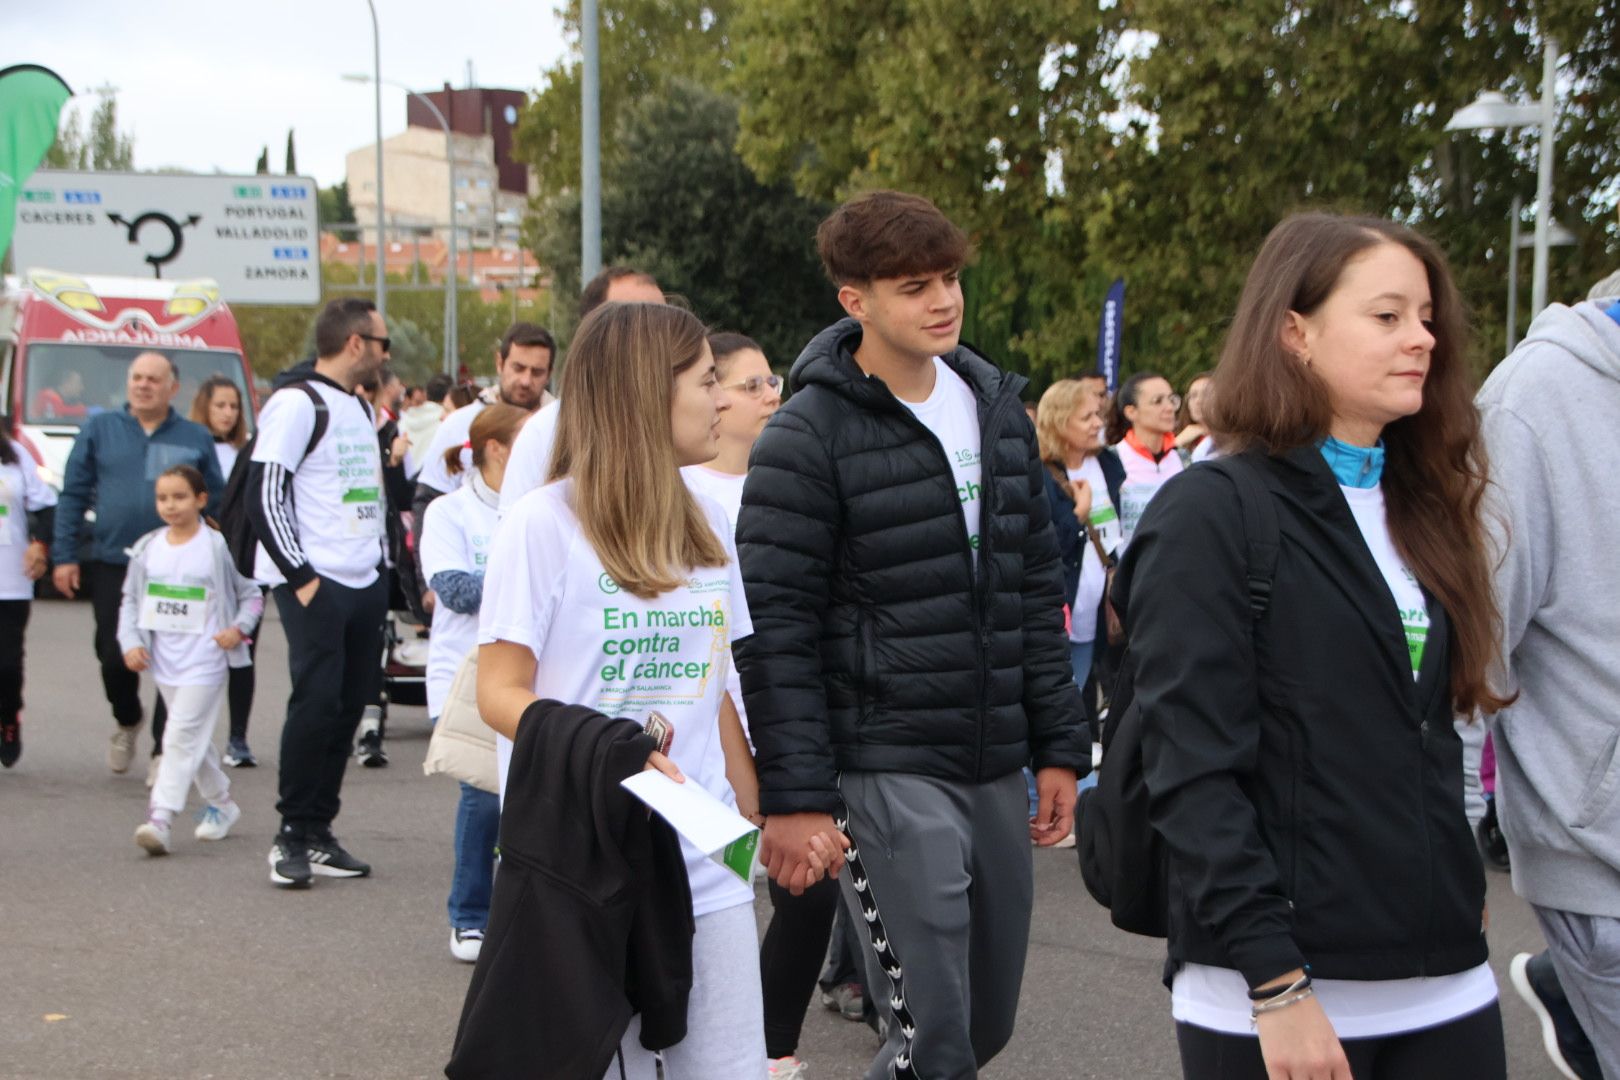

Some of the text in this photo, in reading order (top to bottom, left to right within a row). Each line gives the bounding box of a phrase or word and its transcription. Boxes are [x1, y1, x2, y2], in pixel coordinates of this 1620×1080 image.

[224, 205, 306, 219] PORTUGAL
[216, 226, 308, 240] VALLADOLID
[245, 265, 309, 279] ZAMORA
[603, 606, 724, 630] En marcha
[602, 633, 680, 656] contra
[601, 657, 711, 681] el cáncer
